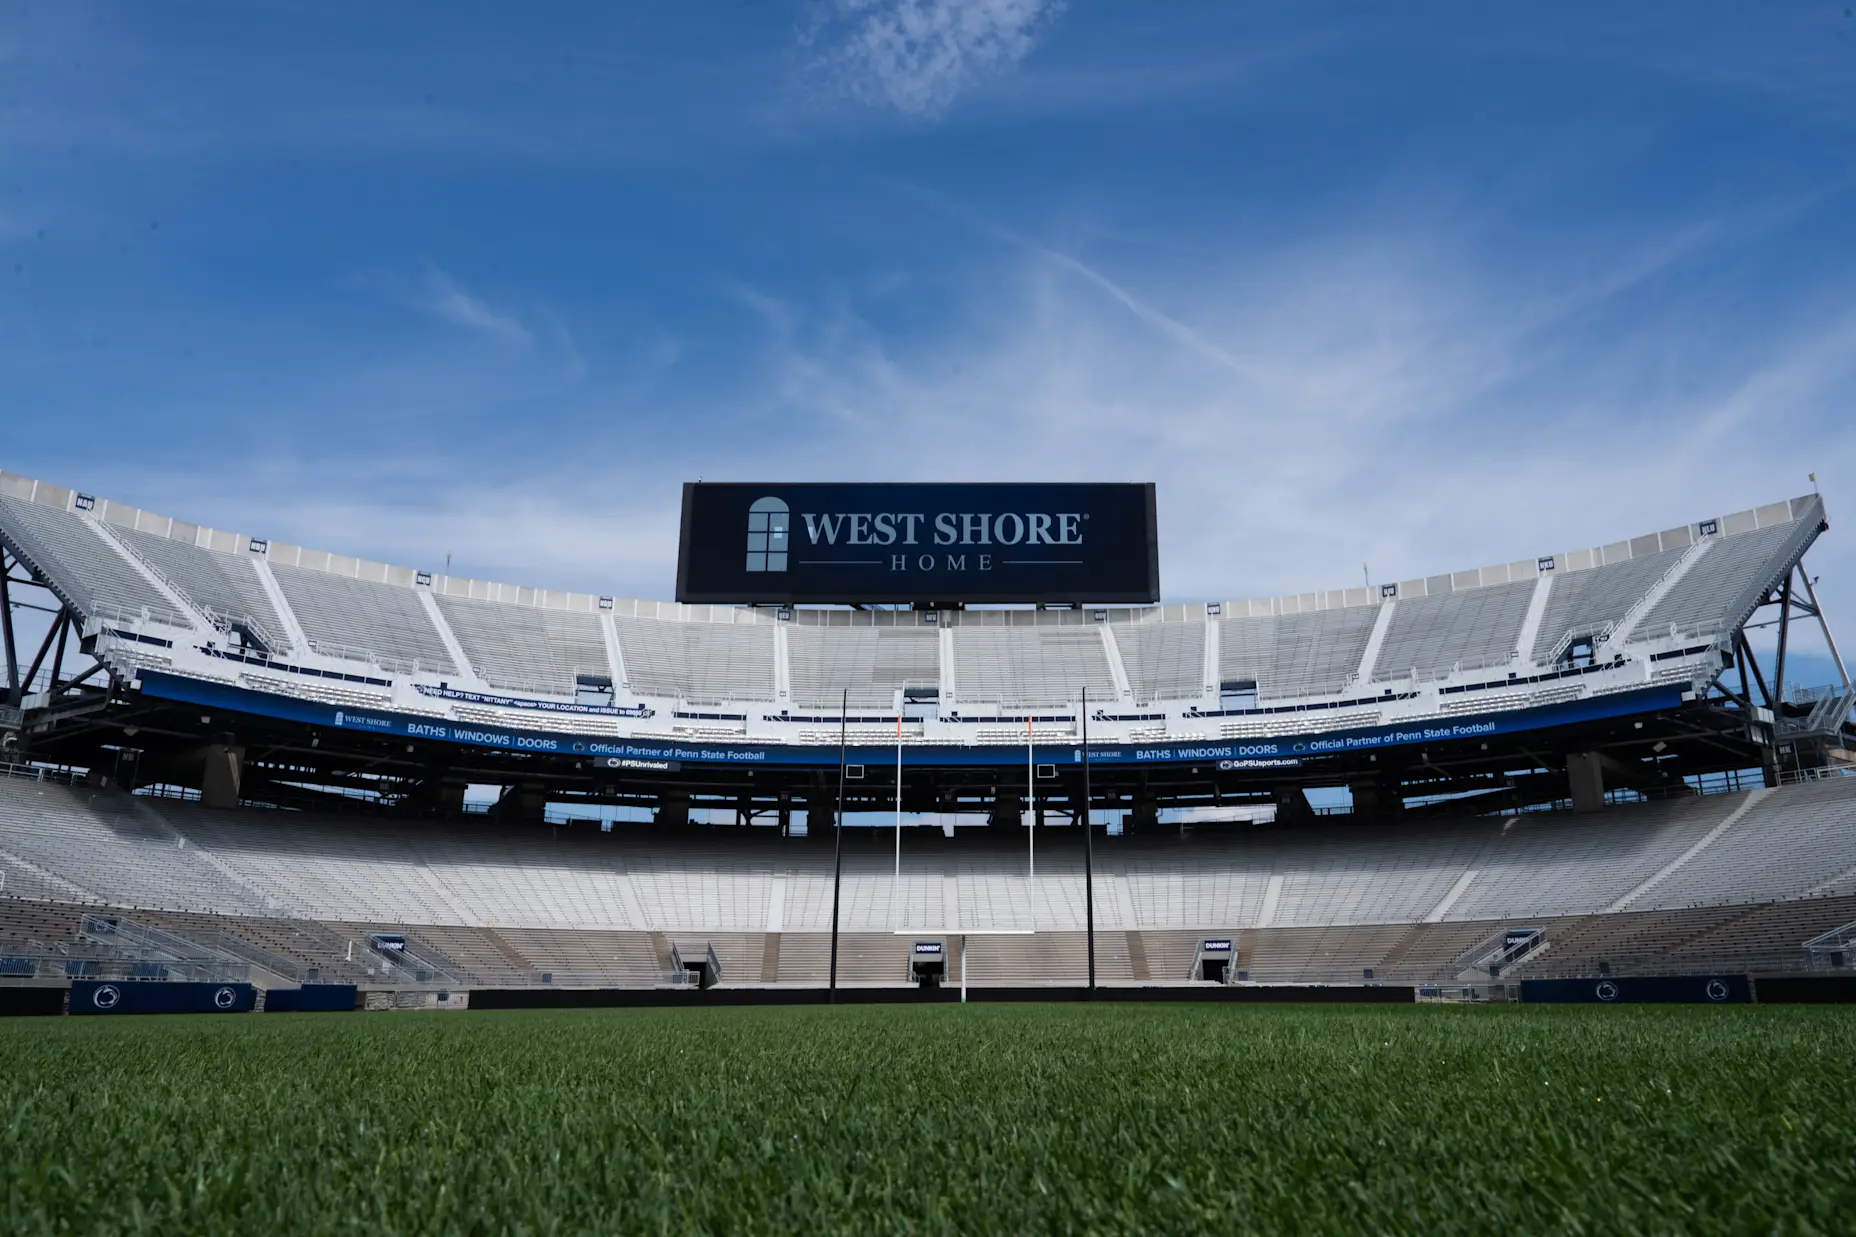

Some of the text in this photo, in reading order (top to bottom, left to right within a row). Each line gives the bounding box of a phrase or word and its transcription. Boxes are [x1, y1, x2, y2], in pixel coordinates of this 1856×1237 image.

[801, 512, 924, 546] WEST
[891, 553, 993, 571] HOME
[424, 687, 442, 696] NEED
[443, 690, 464, 699] HELP?
[465, 692, 481, 701] TEXT
[514, 700, 537, 708] <space>
[556, 704, 588, 712] LOCATION
[600, 707, 619, 715] ISSUE
[345, 715, 392, 727] WEST SHORE
[407, 723, 557, 750] BATHS WINDOWS DOORS
[1310, 722, 1495, 750] Official Partner of Penn State Football
[590, 743, 765, 761] Official Partner of Penn State Football
[1136, 744, 1278, 760] BATHS WINDOWS DOORS
[621, 760, 668, 770] #PSUnrivaled
[1233, 758, 1298, 769] GoPSUsports.com
